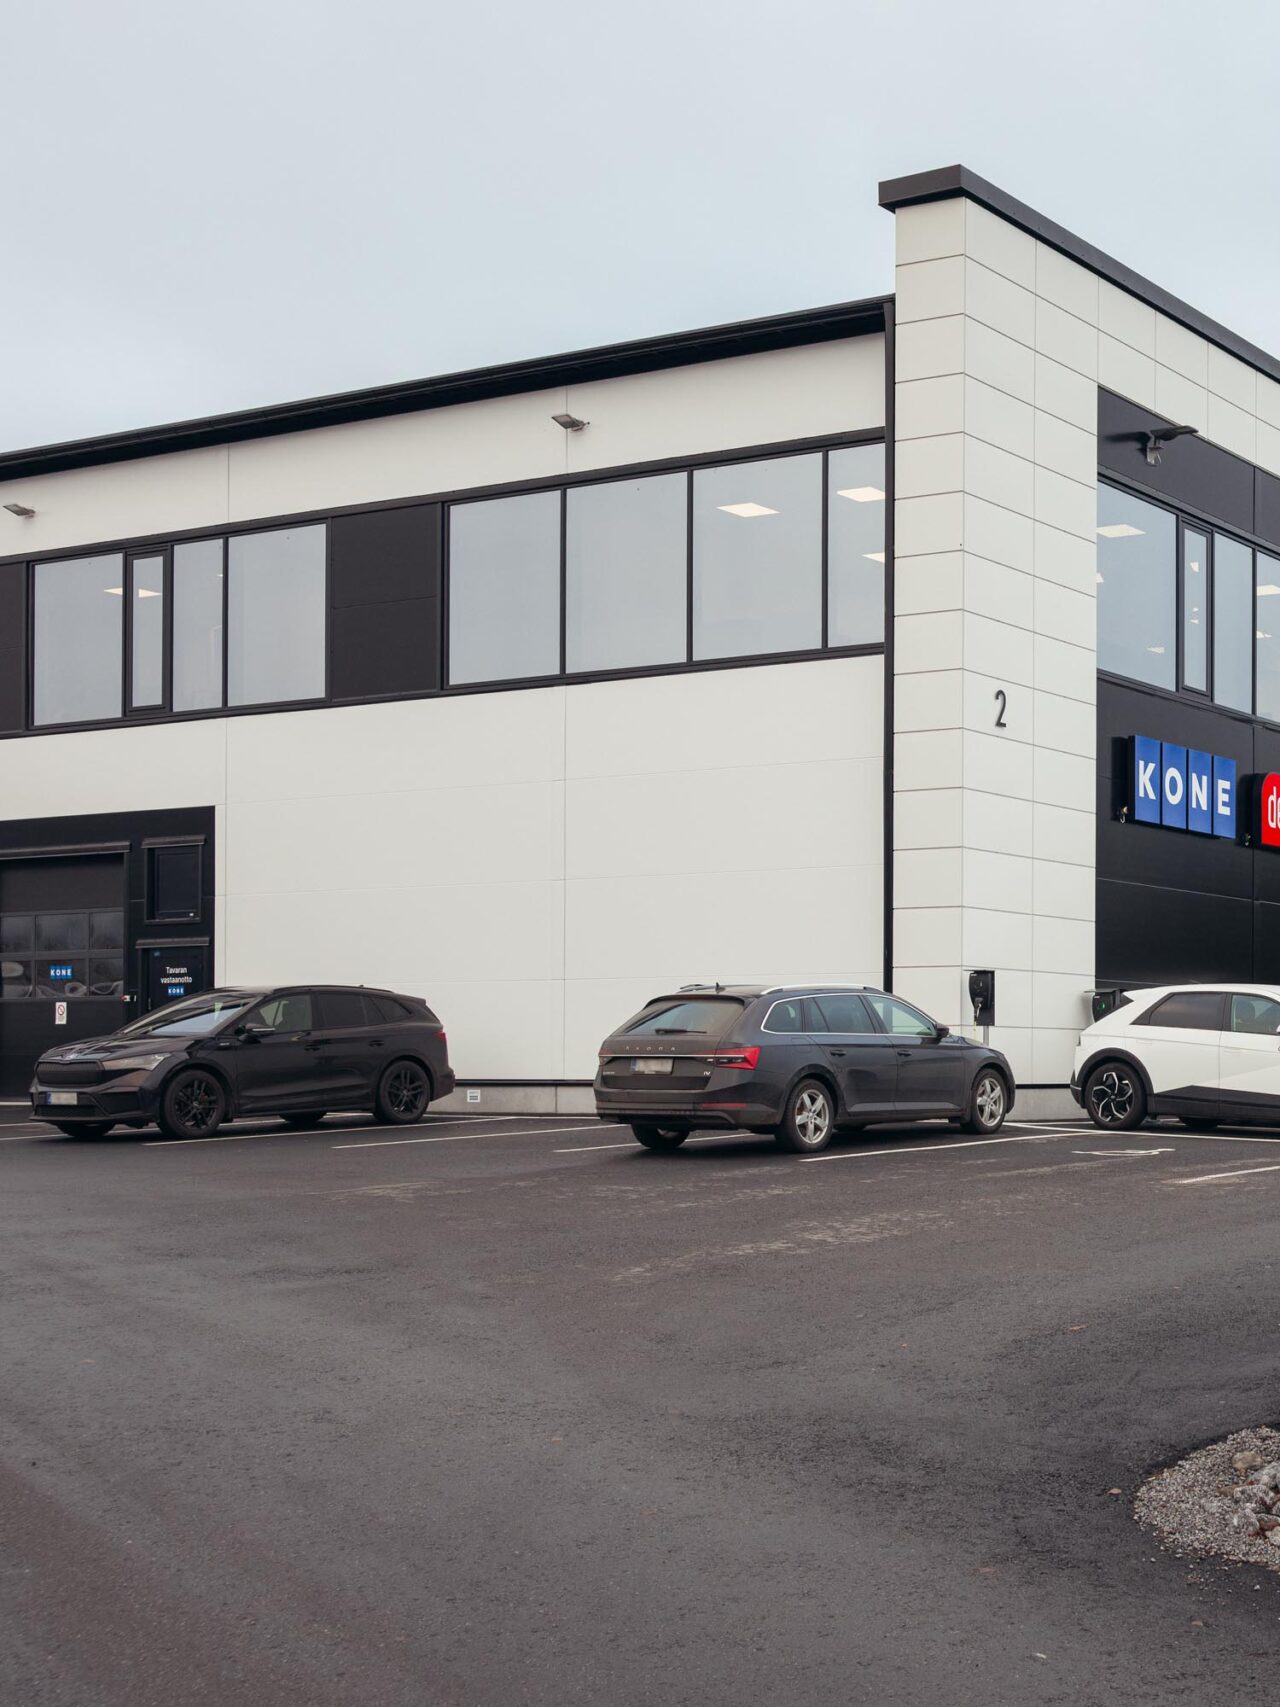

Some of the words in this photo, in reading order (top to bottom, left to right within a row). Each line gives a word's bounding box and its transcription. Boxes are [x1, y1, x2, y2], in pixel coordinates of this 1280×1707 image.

[995, 689, 1007, 728] 2
[1138, 759, 1231, 816] KONE
[50, 968, 72, 976] KONE
[165, 966, 188, 974] Tavaran
[160, 976, 193, 984] vastaanotto
